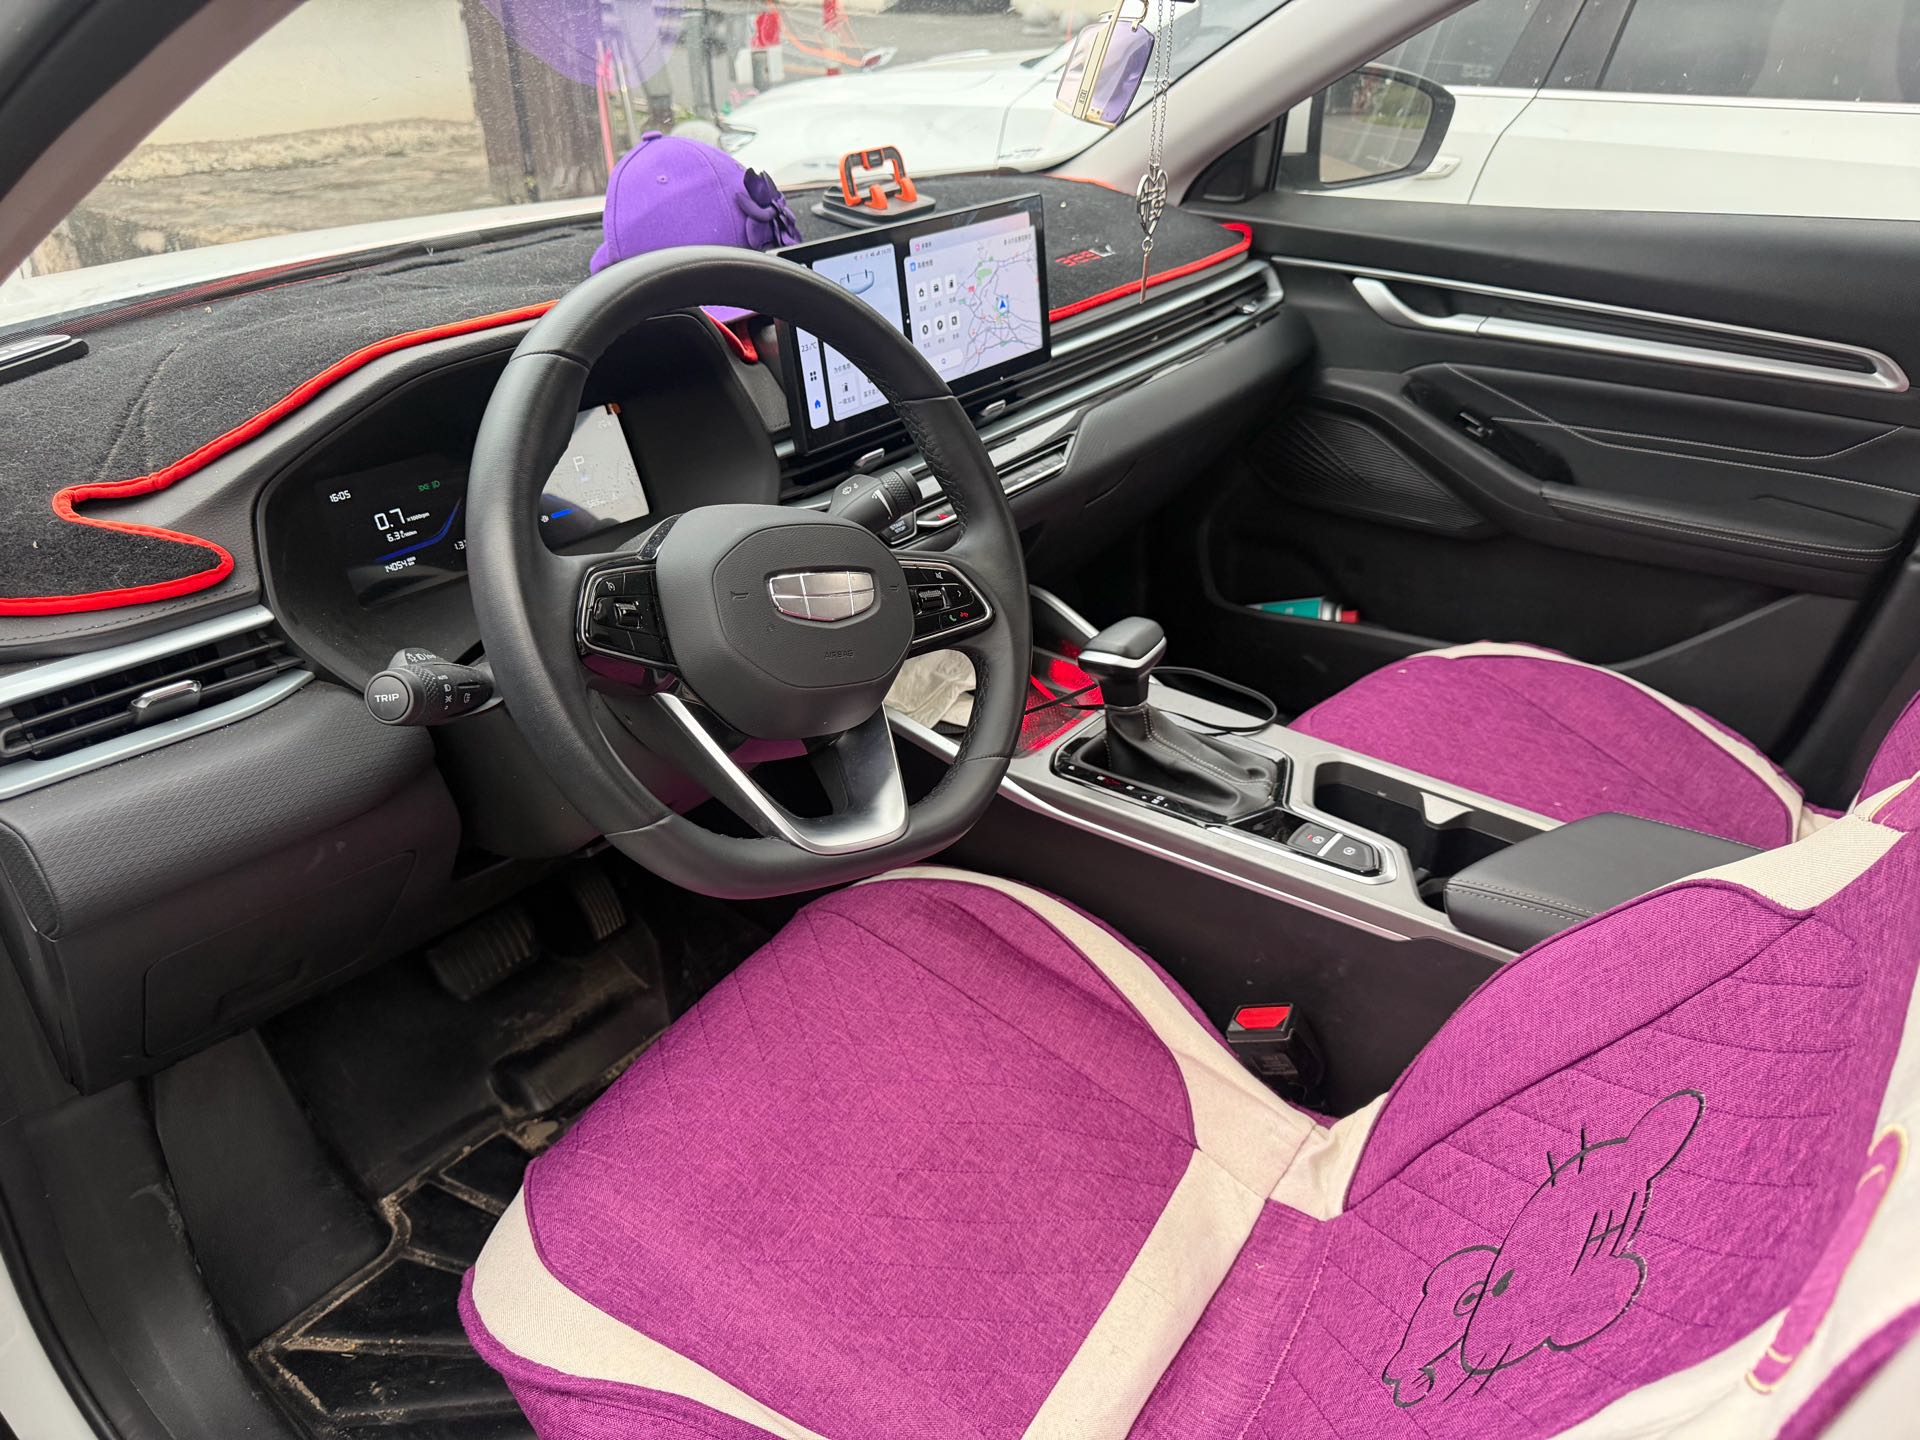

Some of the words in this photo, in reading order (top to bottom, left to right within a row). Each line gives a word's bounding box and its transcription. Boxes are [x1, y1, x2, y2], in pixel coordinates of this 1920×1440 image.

[573, 455, 585, 472] P
[329, 489, 352, 503] 16:05
[373, 507, 405, 531] 0.7
[386, 531, 401, 543] 6.3
[453, 540, 467, 551] 1.3
[384, 559, 408, 573] 14054
[374, 692, 401, 704] TRIP
